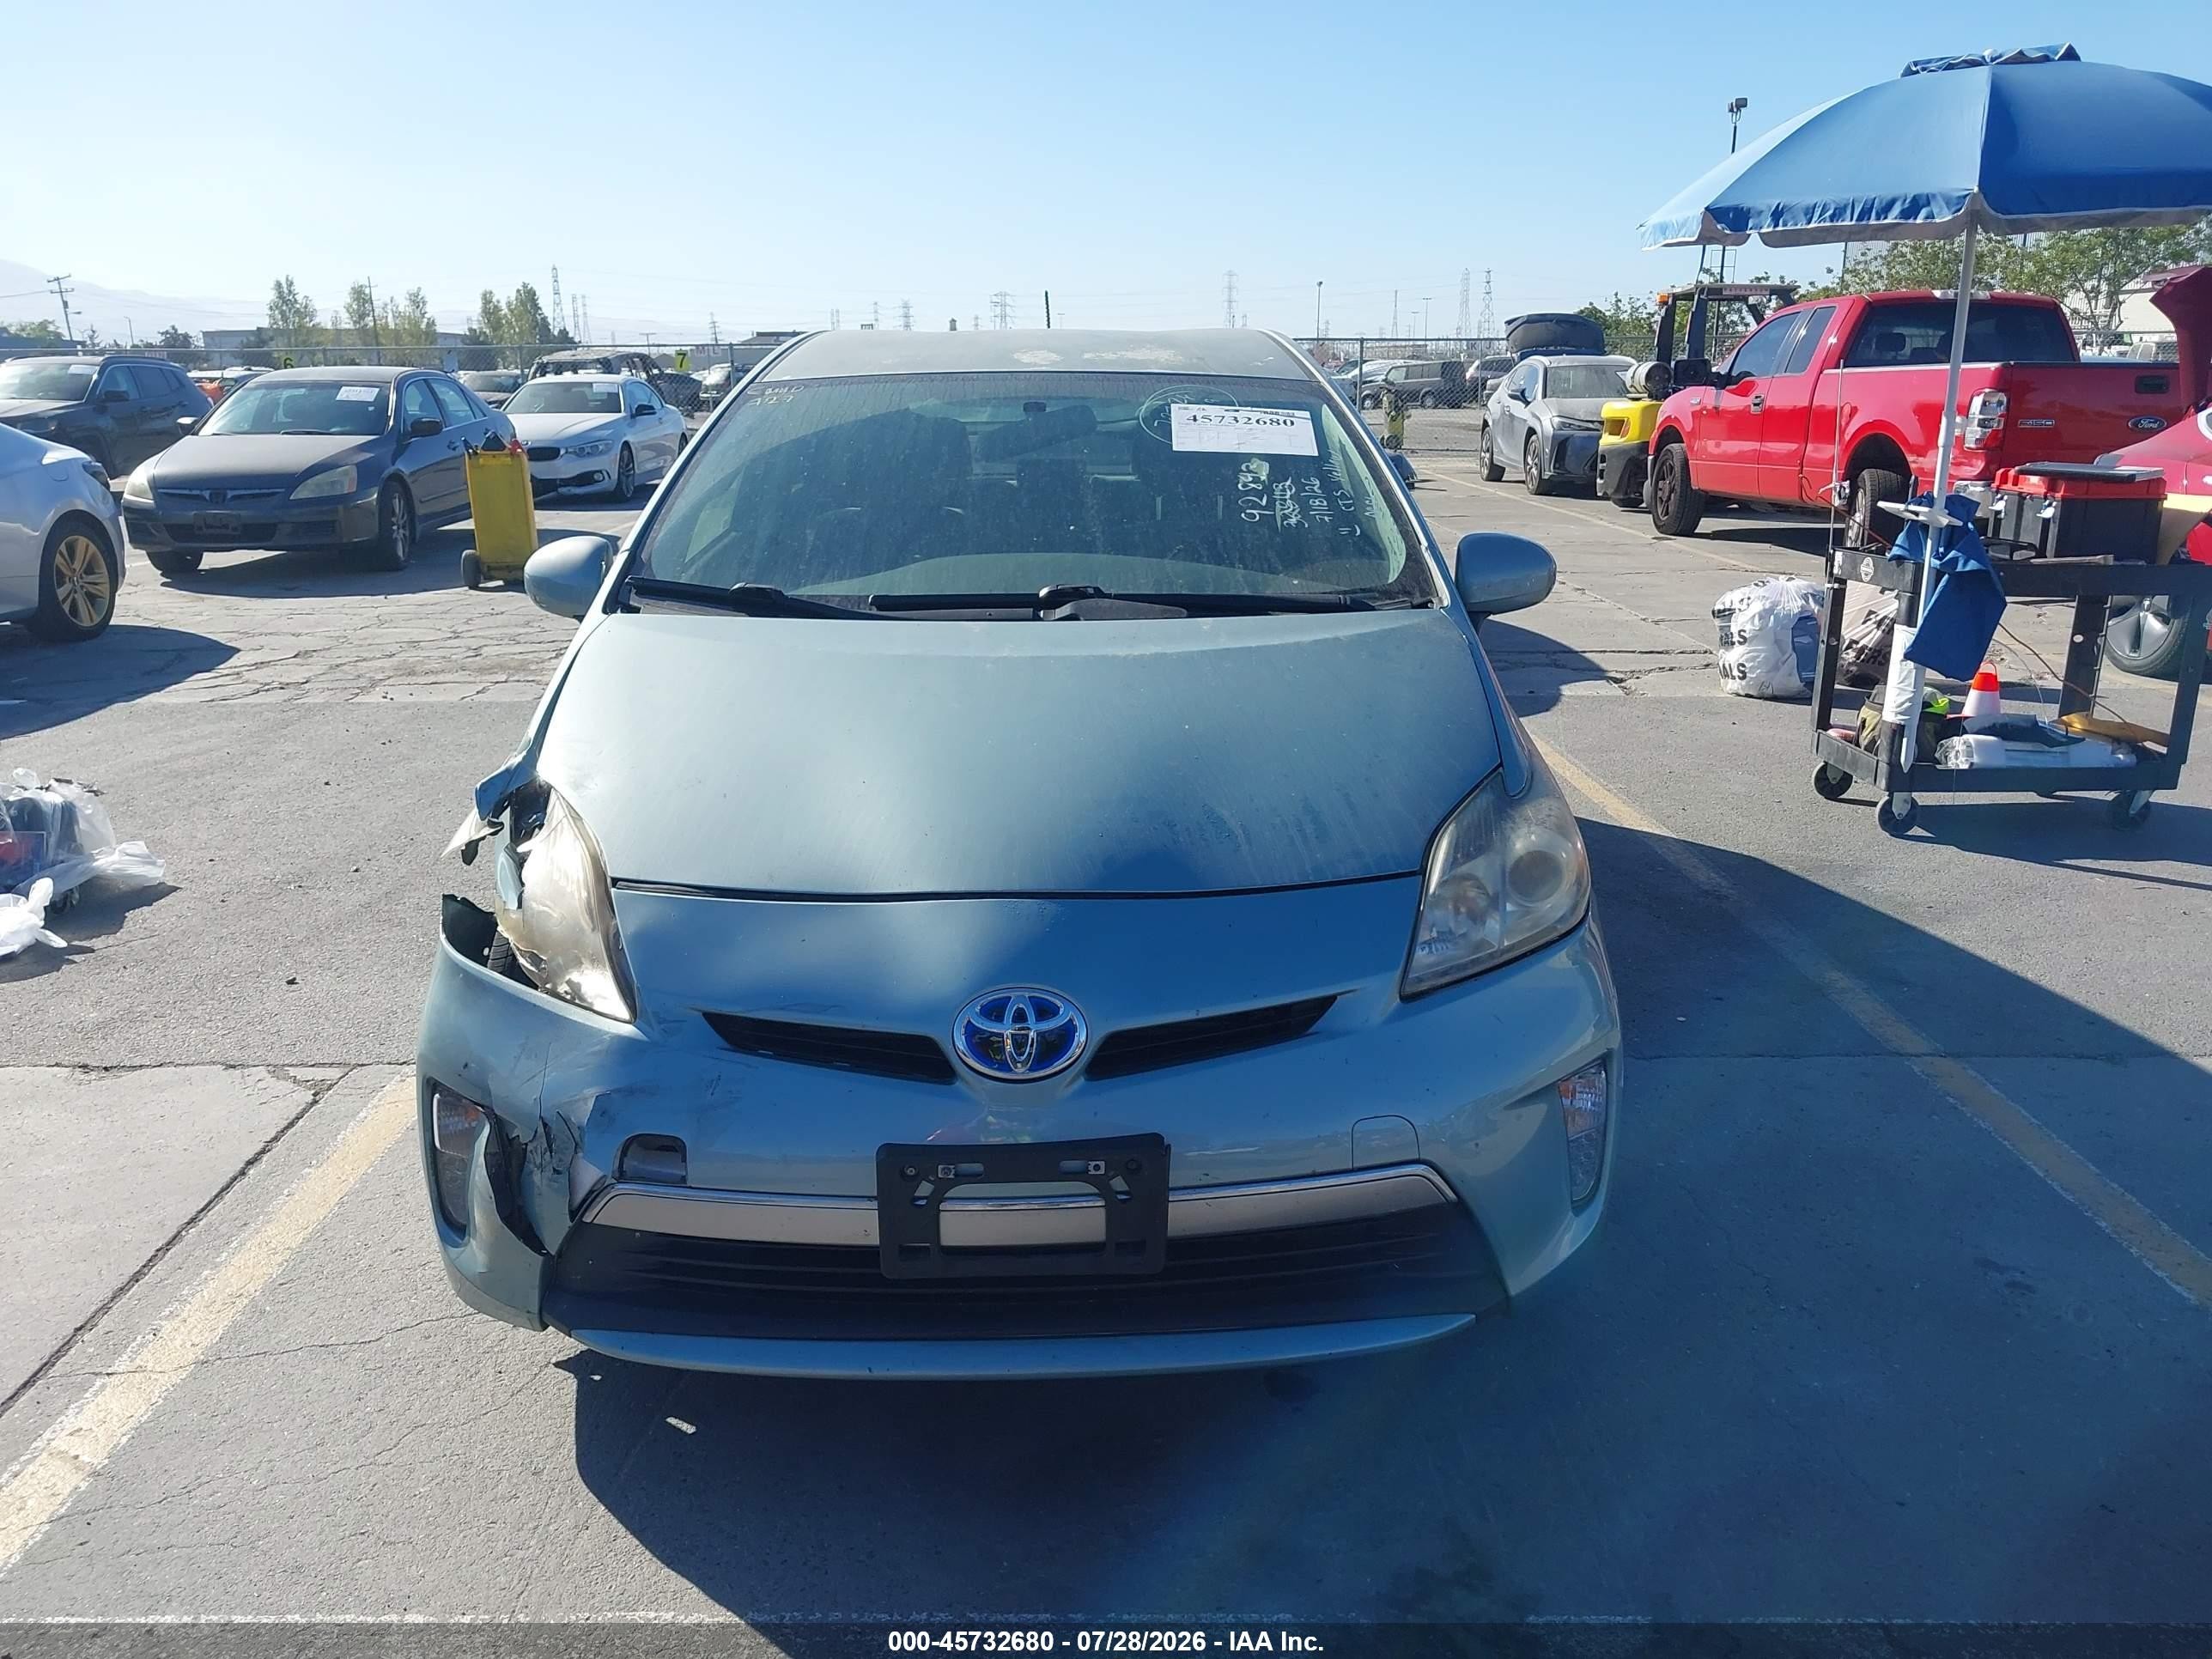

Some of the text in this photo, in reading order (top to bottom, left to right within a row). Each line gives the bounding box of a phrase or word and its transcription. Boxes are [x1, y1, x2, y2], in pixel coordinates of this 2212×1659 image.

[677, 353, 687, 368] 7
[1186, 414, 1296, 428] 45732680
[2137, 417, 2160, 428] Ford
